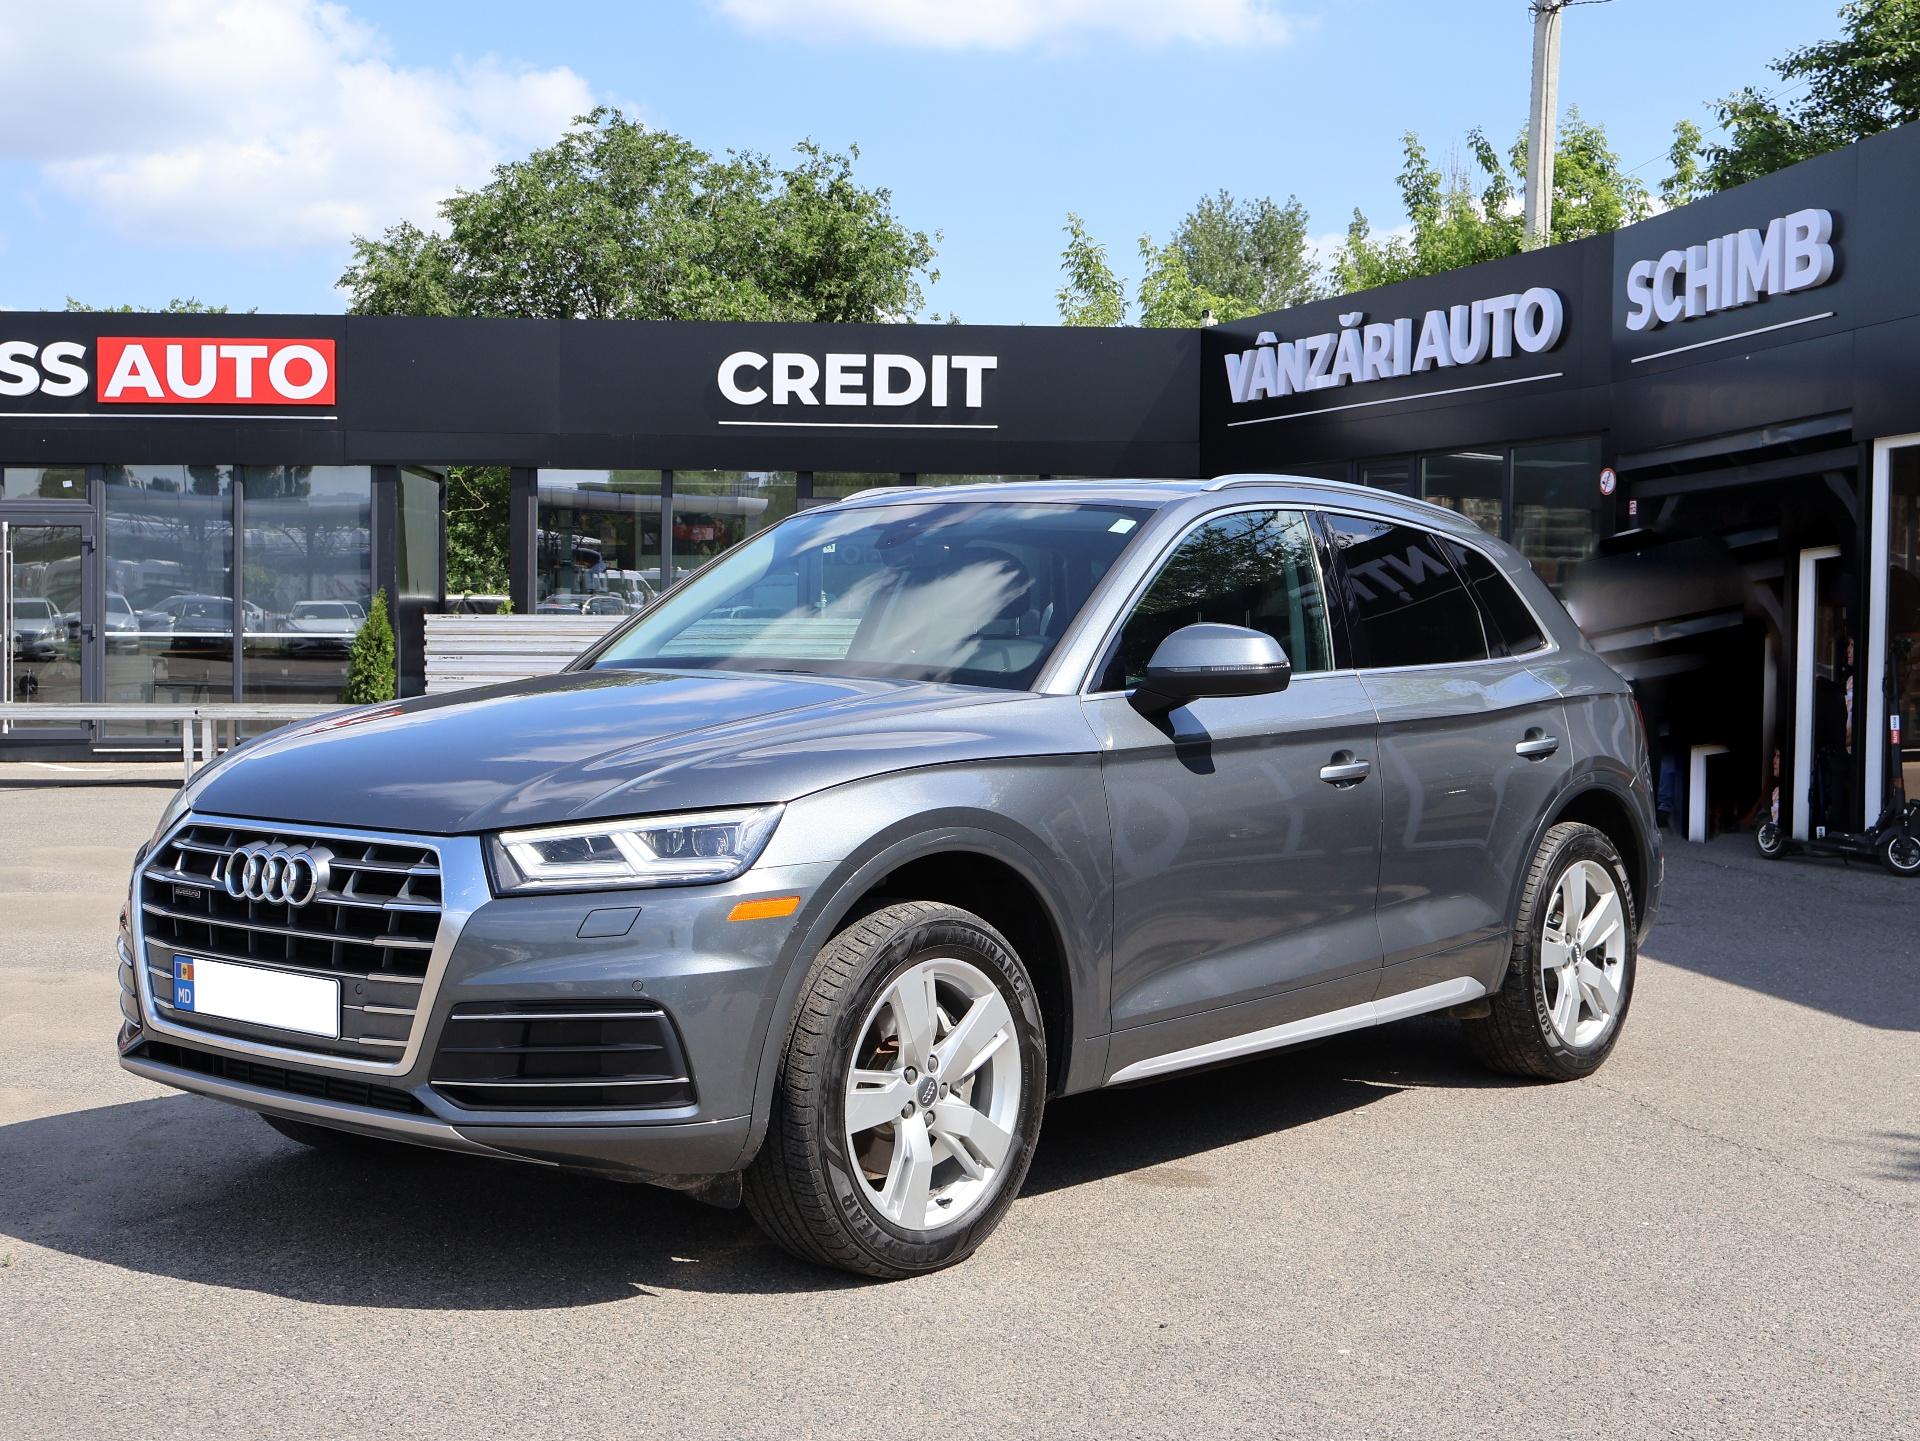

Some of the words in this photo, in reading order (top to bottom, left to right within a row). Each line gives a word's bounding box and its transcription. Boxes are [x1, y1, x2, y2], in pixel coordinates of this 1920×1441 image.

[1627, 209, 1834, 331] SCHIMB
[0, 340, 89, 397] SS
[104, 344, 328, 398] AUTO
[1224, 312, 1412, 403] VÂNZĂRI
[1413, 287, 1563, 370] AUTO
[717, 350, 998, 407] CREDIT
[178, 988, 192, 1004] MD
